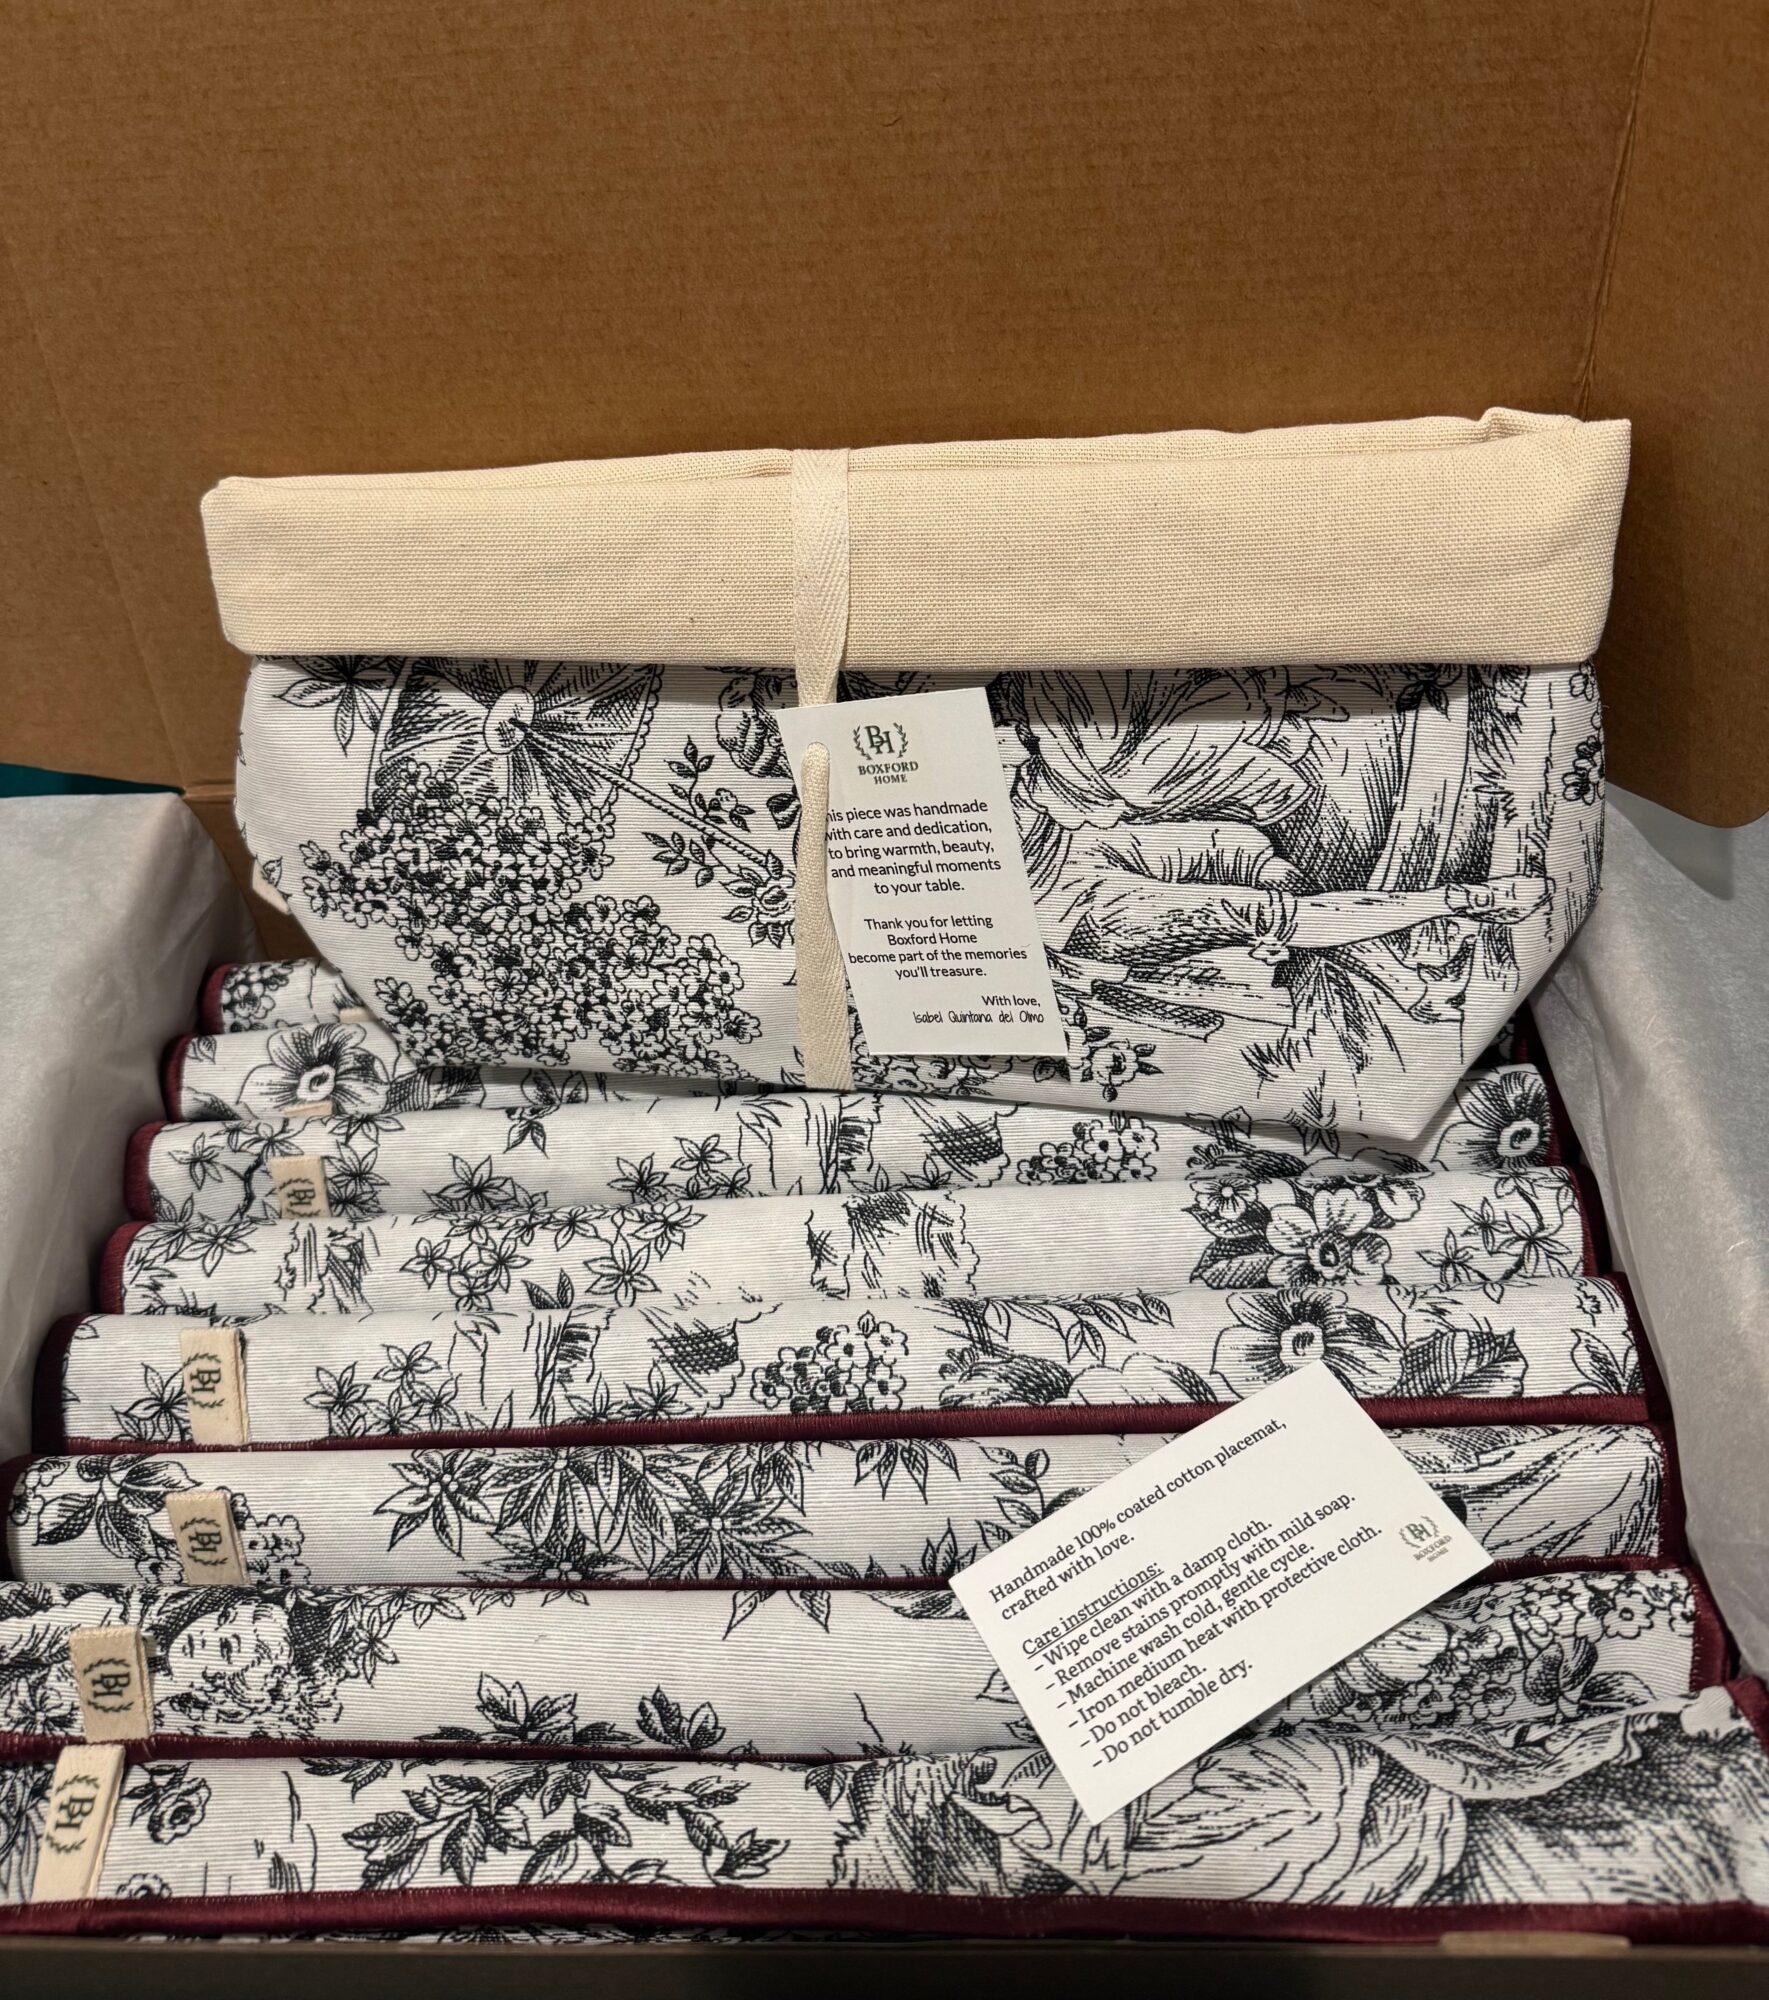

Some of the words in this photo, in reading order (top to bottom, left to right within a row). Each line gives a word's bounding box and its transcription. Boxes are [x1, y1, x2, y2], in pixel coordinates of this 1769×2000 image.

[858, 761, 919, 775] BOXFORD
[874, 774, 908, 785] HOME
[826, 808, 844, 822] his
[846, 808, 882, 823] piece
[884, 808, 911, 818] was
[913, 799, 988, 816] handmade
[854, 829, 883, 839] care
[886, 824, 911, 837] and
[914, 820, 992, 835] dedication,
[828, 848, 843, 859] to
[844, 846, 882, 860] bring
[882, 841, 940, 856] warmth,
[942, 840, 994, 854] beauty,
[832, 864, 856, 878] and
[858, 860, 933, 877] meaningful
[936, 859, 1001, 872] moments
[874, 883, 889, 894] to
[891, 883, 922, 896] your
[925, 878, 964, 892] table.
[864, 918, 904, 930] Thank
[905, 920, 928, 931] you
[930, 916, 948, 927] for
[951, 915, 994, 928] letting
[887, 933, 937, 946] Boxford
[939, 932, 978, 944] Home
[848, 953, 896, 964] become
[899, 951, 924, 964] part
[926, 950, 938, 961] of
[941, 949, 962, 960] the
[965, 948, 1027, 960] memories
[930, 967, 986, 977] treasure.
[982, 996, 1012, 1006] With
[1013, 995, 1040, 1007] love,
[913, 1012, 943, 1024] Isabel
[948, 1011, 993, 1023] Quintana
[999, 1011, 1014, 1023] del
[1020, 1010, 1044, 1023] Olmo
[989, 1545, 1076, 1603] Handmade
[1074, 1520, 1116, 1549] 100%
[1117, 1485, 1167, 1523] coated
[1167, 1460, 1216, 1492] cotton
[1214, 1419, 1287, 1467] placemat,
[1002, 1576, 1059, 1620] crafted
[1058, 1555, 1096, 1582] with
[1094, 1534, 1134, 1560] love.
[1042, 1634, 1089, 1665] Wipe
[1090, 1607, 1134, 1637] clean
[1132, 1581, 1172, 1609] with
[1171, 1575, 1183, 1586] a
[1183, 1546, 1226, 1578] damp
[1228, 1521, 1272, 1550] cloth.
[1055, 1639, 1121, 1686] Remove
[1122, 1607, 1170, 1643] stains
[1168, 1560, 1241, 1616] promptly
[1241, 1538, 1280, 1564] with
[1278, 1512, 1316, 1542] mild
[1315, 1495, 1355, 1520] soap.
[1023, 1627, 1061, 1654] Care
[1060, 1563, 1164, 1631] instructions:
[1066, 1653, 1139, 1704] Machine
[1138, 1624, 1179, 1656] wash
[1176, 1598, 1223, 1634] cold,
[1218, 1568, 1270, 1607] gentle
[1271, 1544, 1314, 1572] cycle.
[1078, 1694, 1118, 1723] Iron
[1117, 1649, 1187, 1698] medium
[1182, 1623, 1223, 1653] heat
[1221, 1600, 1261, 1628] with
[1259, 1552, 1338, 1608] protective
[1338, 1527, 1382, 1555] cloth.
[1090, 1722, 1116, 1743] Do
[1117, 1699, 1148, 1726] not
[1144, 1664, 1206, 1705] bleach.
[1102, 1741, 1128, 1762] Do
[1129, 1718, 1161, 1745] not
[1159, 1681, 1219, 1724] tumble
[1220, 1660, 1252, 1685] dry.
